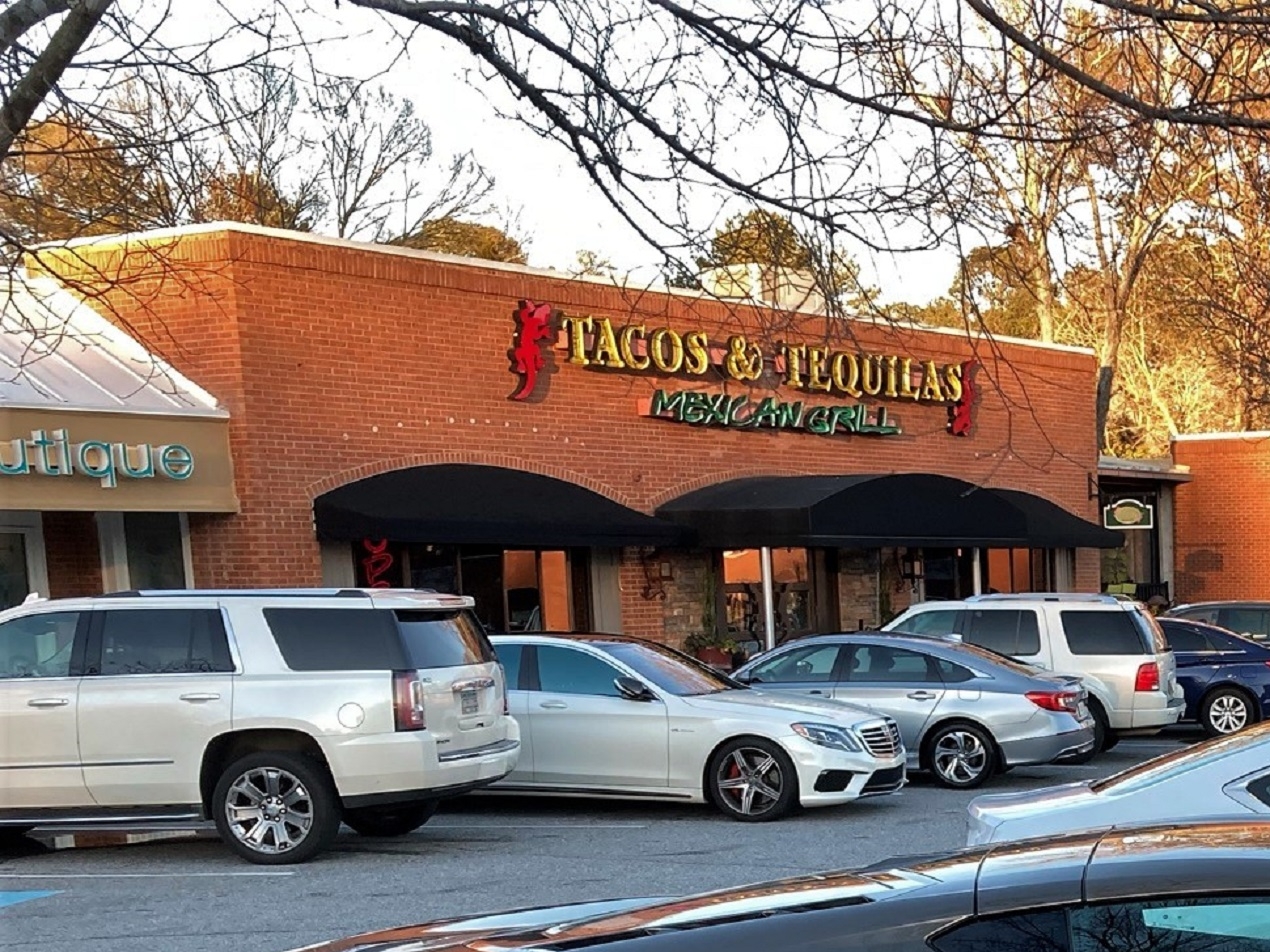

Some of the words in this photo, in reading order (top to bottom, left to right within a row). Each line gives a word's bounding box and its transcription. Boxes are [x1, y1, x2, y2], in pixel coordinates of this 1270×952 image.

[563, 315, 709, 376] TACOS
[726, 334, 763, 380] &
[781, 341, 963, 402] TEQUILAS
[652, 389, 801, 429] MEXICAN
[801, 402, 901, 435] GRILL
[0, 428, 195, 488] utique
